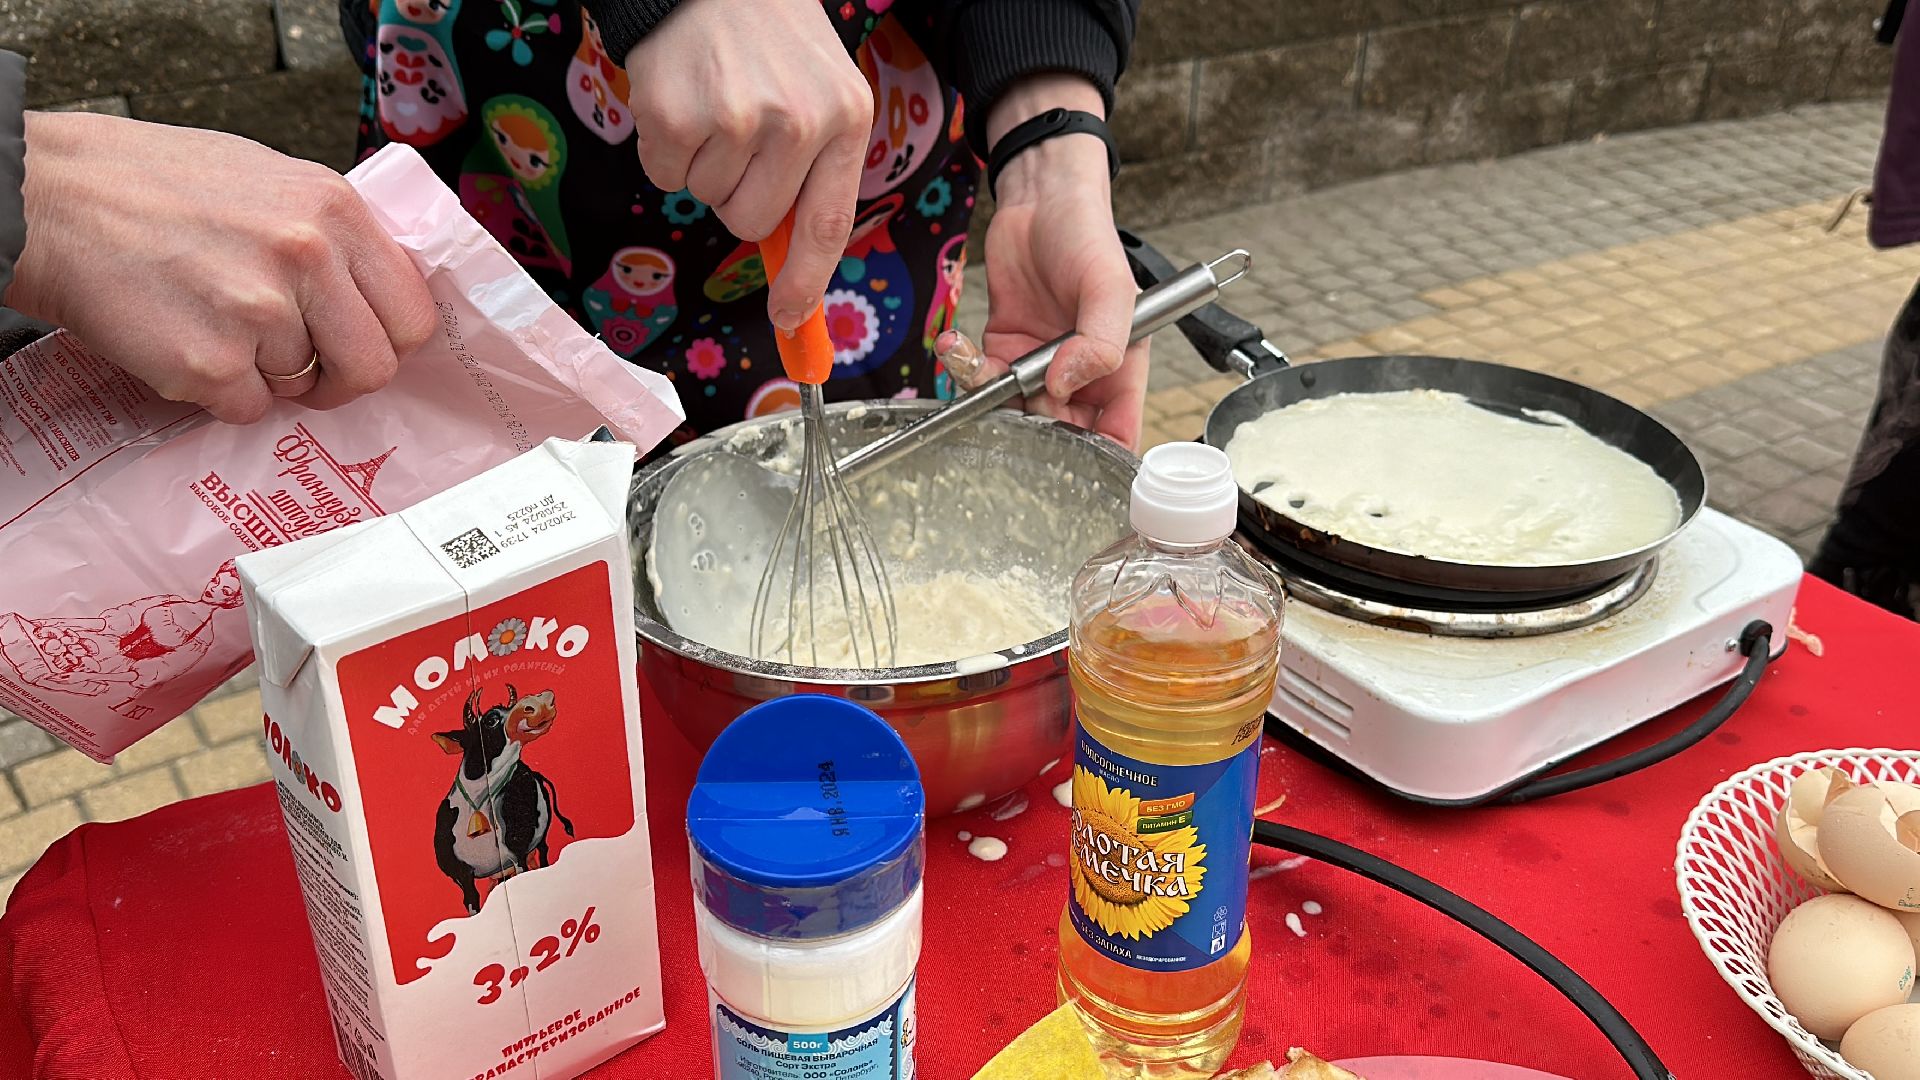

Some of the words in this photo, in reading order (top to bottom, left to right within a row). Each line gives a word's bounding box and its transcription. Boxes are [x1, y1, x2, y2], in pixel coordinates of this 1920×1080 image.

[53, 351, 69, 367] НЕ
[51, 427, 81, 462] МЕСЯЦЕВ
[190, 482, 231, 524] ВЫСОКОЕ
[521, 501, 568, 525] 25/08/24
[530, 510, 577, 535] 25/02/24
[500, 531, 529, 549] 17:39
[1081, 739, 1158, 787] ПОДСОЛНЕЧНОЕ
[1099, 768, 1120, 783] МАСЛО
[1146, 805, 1165, 813] БЕЗ
[1166, 800, 1186, 810] ГМО
[1080, 921, 1094, 940] БЕЗ
[1095, 935, 1133, 959] ЗАПАХА
[473, 906, 601, 1005] 3,2%
[469, 986, 642, 1080] РАПАСТЕРИЗОВАННОЕ
[501, 1008, 582, 1058] ПИТЬЕВОЕ
[792, 1041, 823, 1050] 500г
[736, 1037, 761, 1053] СОЛЬ
[760, 1050, 812, 1062] ПИЩЕВАЯ
[812, 1037, 879, 1062] ВЫВАРОЧНАЯ
[775, 1060, 800, 1070] Сорт
[801, 1060, 837, 1070] Экстра
[803, 1071, 827, 1079] ООО
